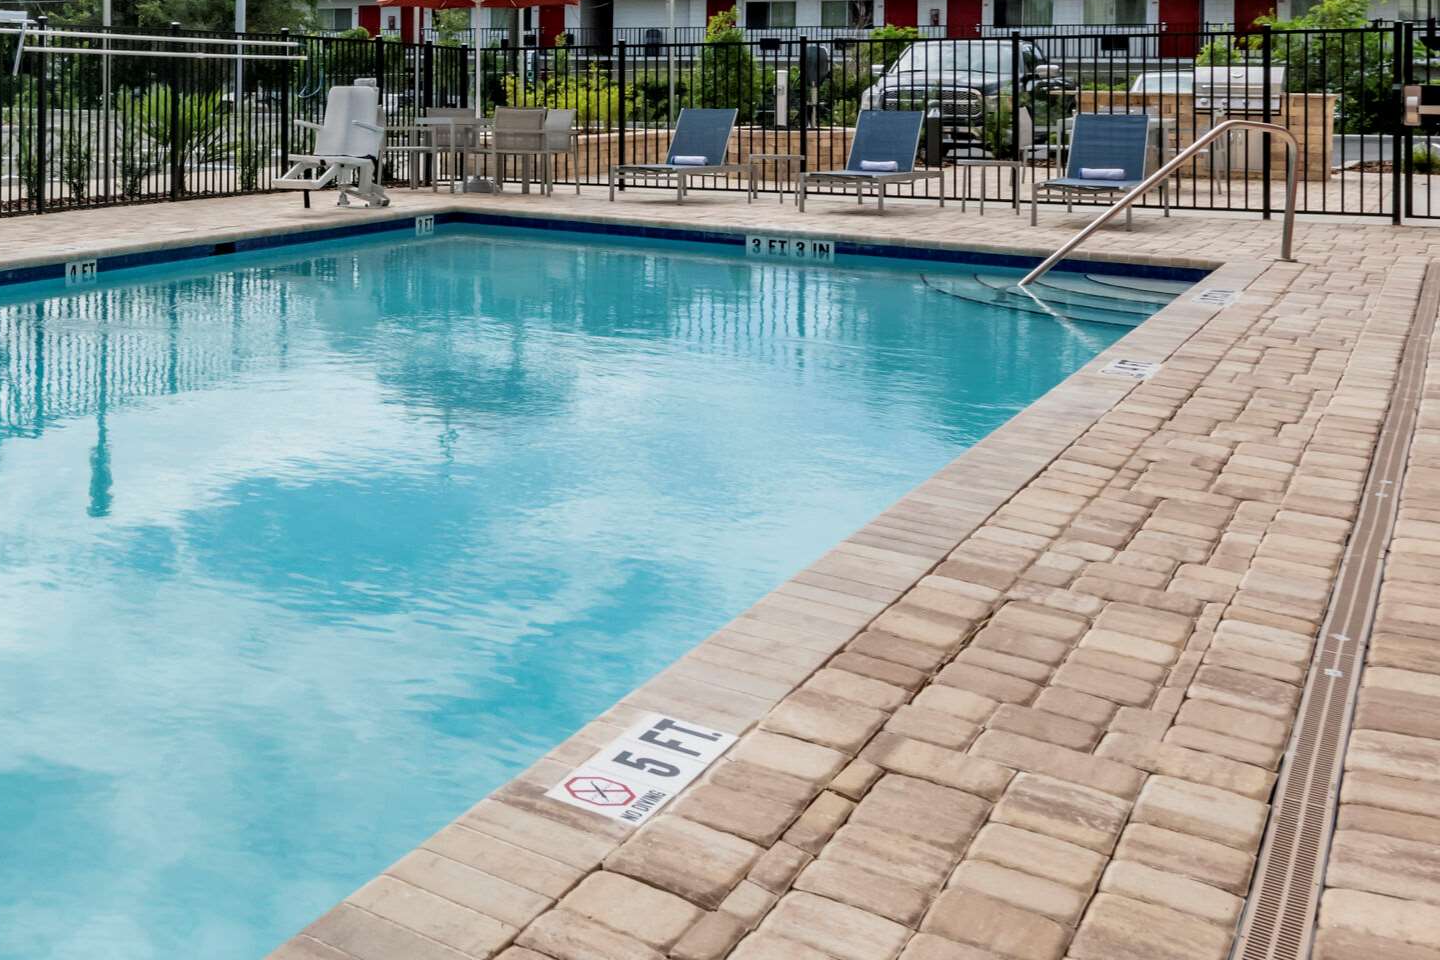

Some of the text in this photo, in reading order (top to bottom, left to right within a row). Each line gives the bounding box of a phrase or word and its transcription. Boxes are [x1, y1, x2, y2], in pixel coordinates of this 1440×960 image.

[612, 750, 681, 778] 5
[620, 789, 666, 822] NO DIVING
